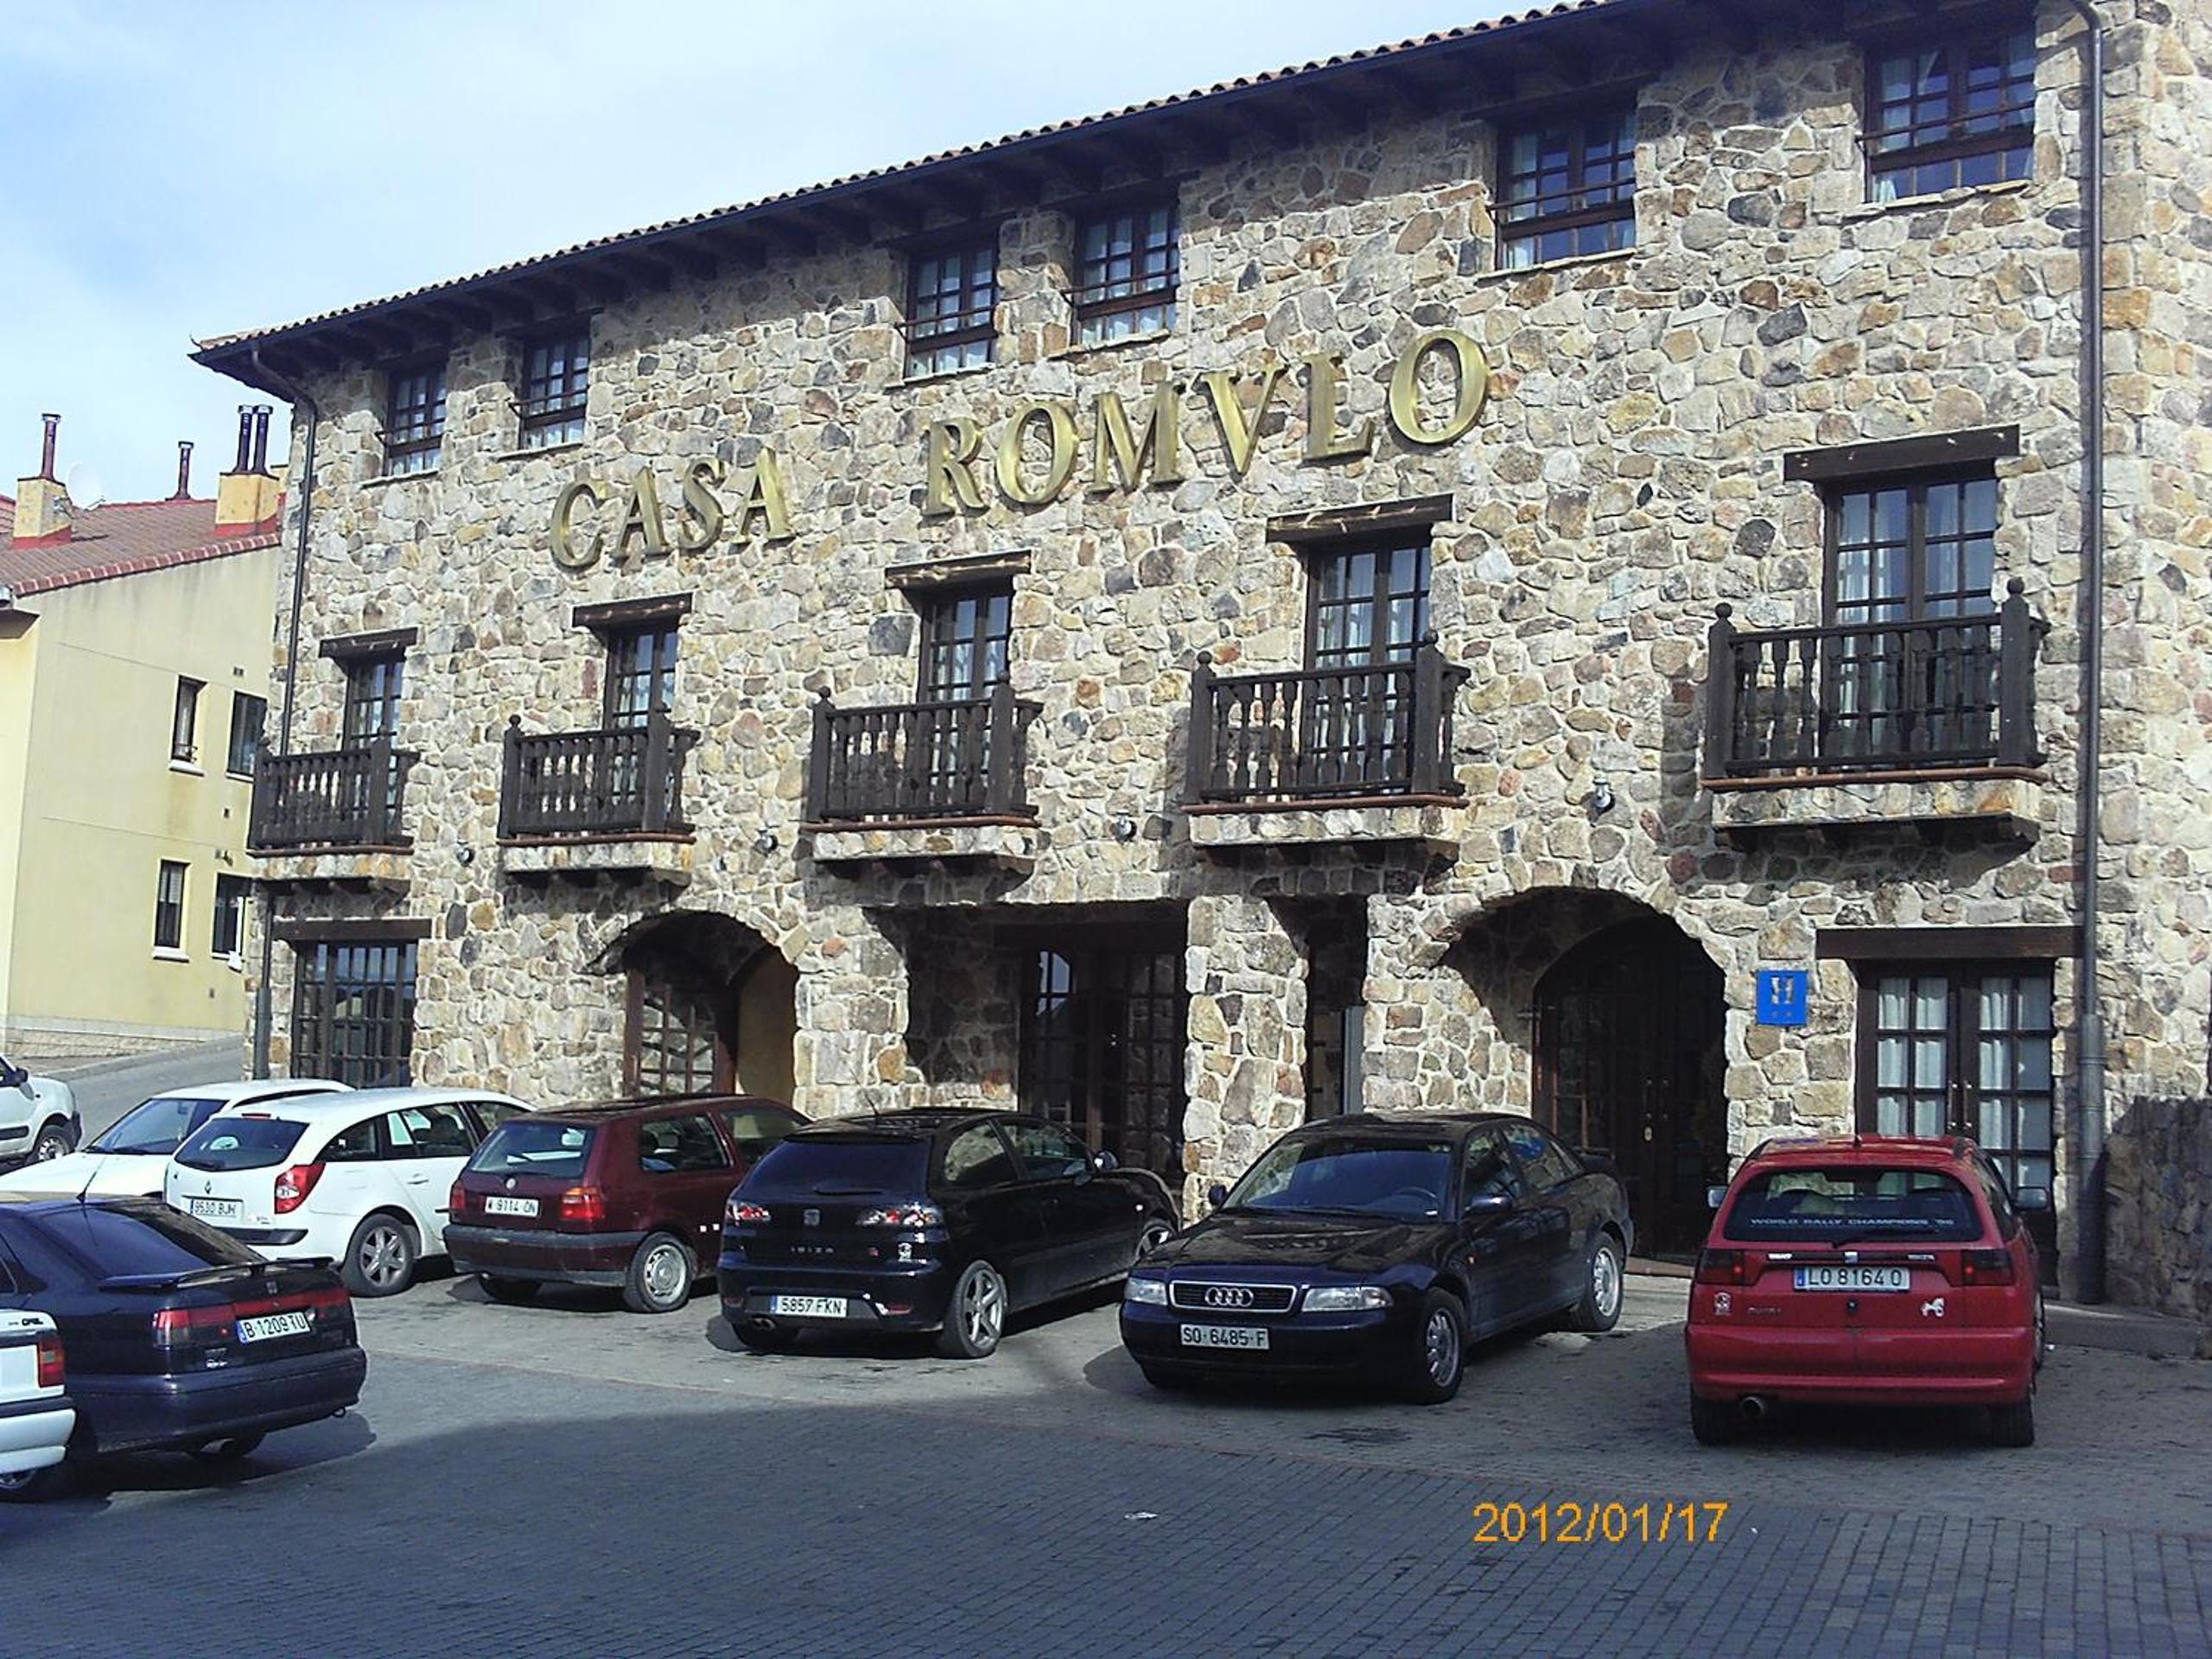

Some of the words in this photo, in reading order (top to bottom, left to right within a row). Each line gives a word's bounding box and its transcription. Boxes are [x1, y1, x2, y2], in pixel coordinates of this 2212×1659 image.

[550, 447, 795, 568] CASA
[920, 328, 1490, 517] ROMVLO
[1808, 1266, 1832, 1286] LO
[1837, 1266, 1885, 1286] 8164
[781, 1297, 814, 1313] 5857
[817, 1299, 842, 1314] FKN
